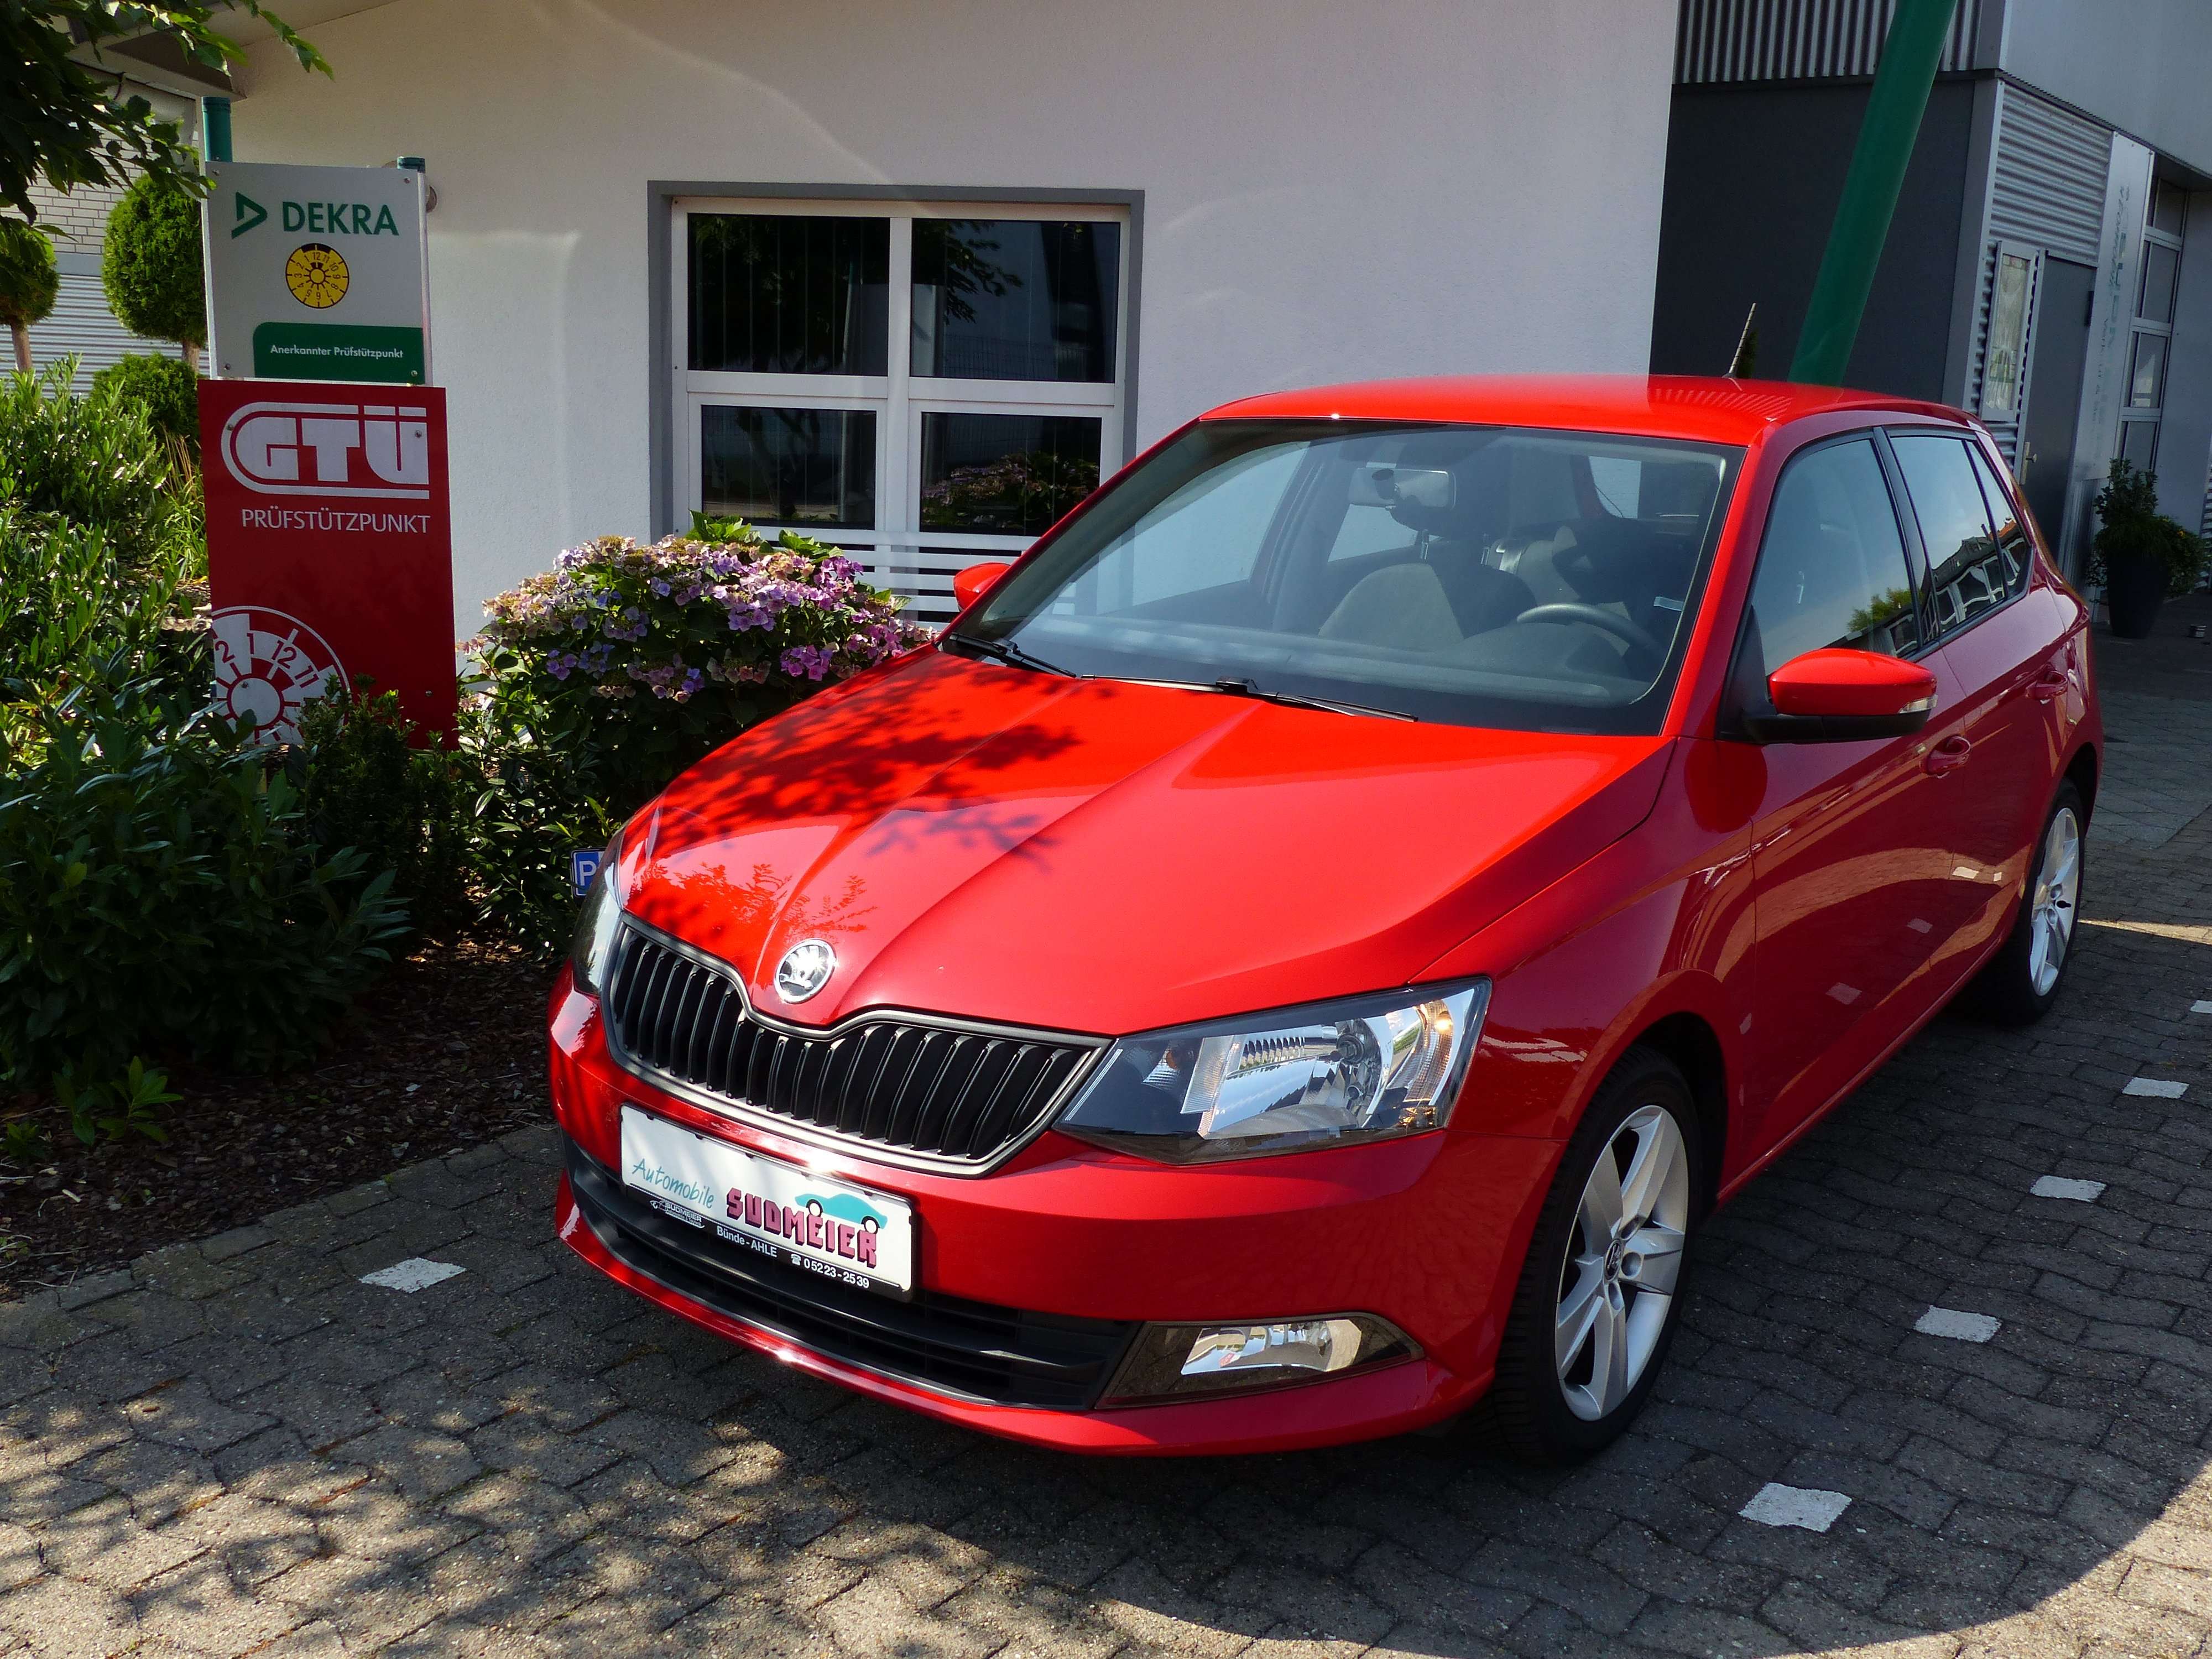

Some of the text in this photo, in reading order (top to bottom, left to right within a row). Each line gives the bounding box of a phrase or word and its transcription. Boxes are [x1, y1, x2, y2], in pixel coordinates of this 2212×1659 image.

[283, 201, 399, 236] DEKRA
[312, 252, 321, 260] 12
[323, 254, 330, 263] 11
[329, 263, 339, 272] 10
[306, 289, 312, 298] 5
[326, 289, 332, 298] 7
[270, 345, 403, 359] Anerkannter Prüfstützpunkt
[232, 403, 430, 486] GTÜ
[241, 505, 431, 534] PRÜFSTÜTZPUNKT
[215, 633, 320, 688] 2 1 12 11
[579, 860, 597, 886] P
[632, 1158, 877, 1269] Automobile SUDMEIER
[804, 1258, 870, 1289] 05223-2539
